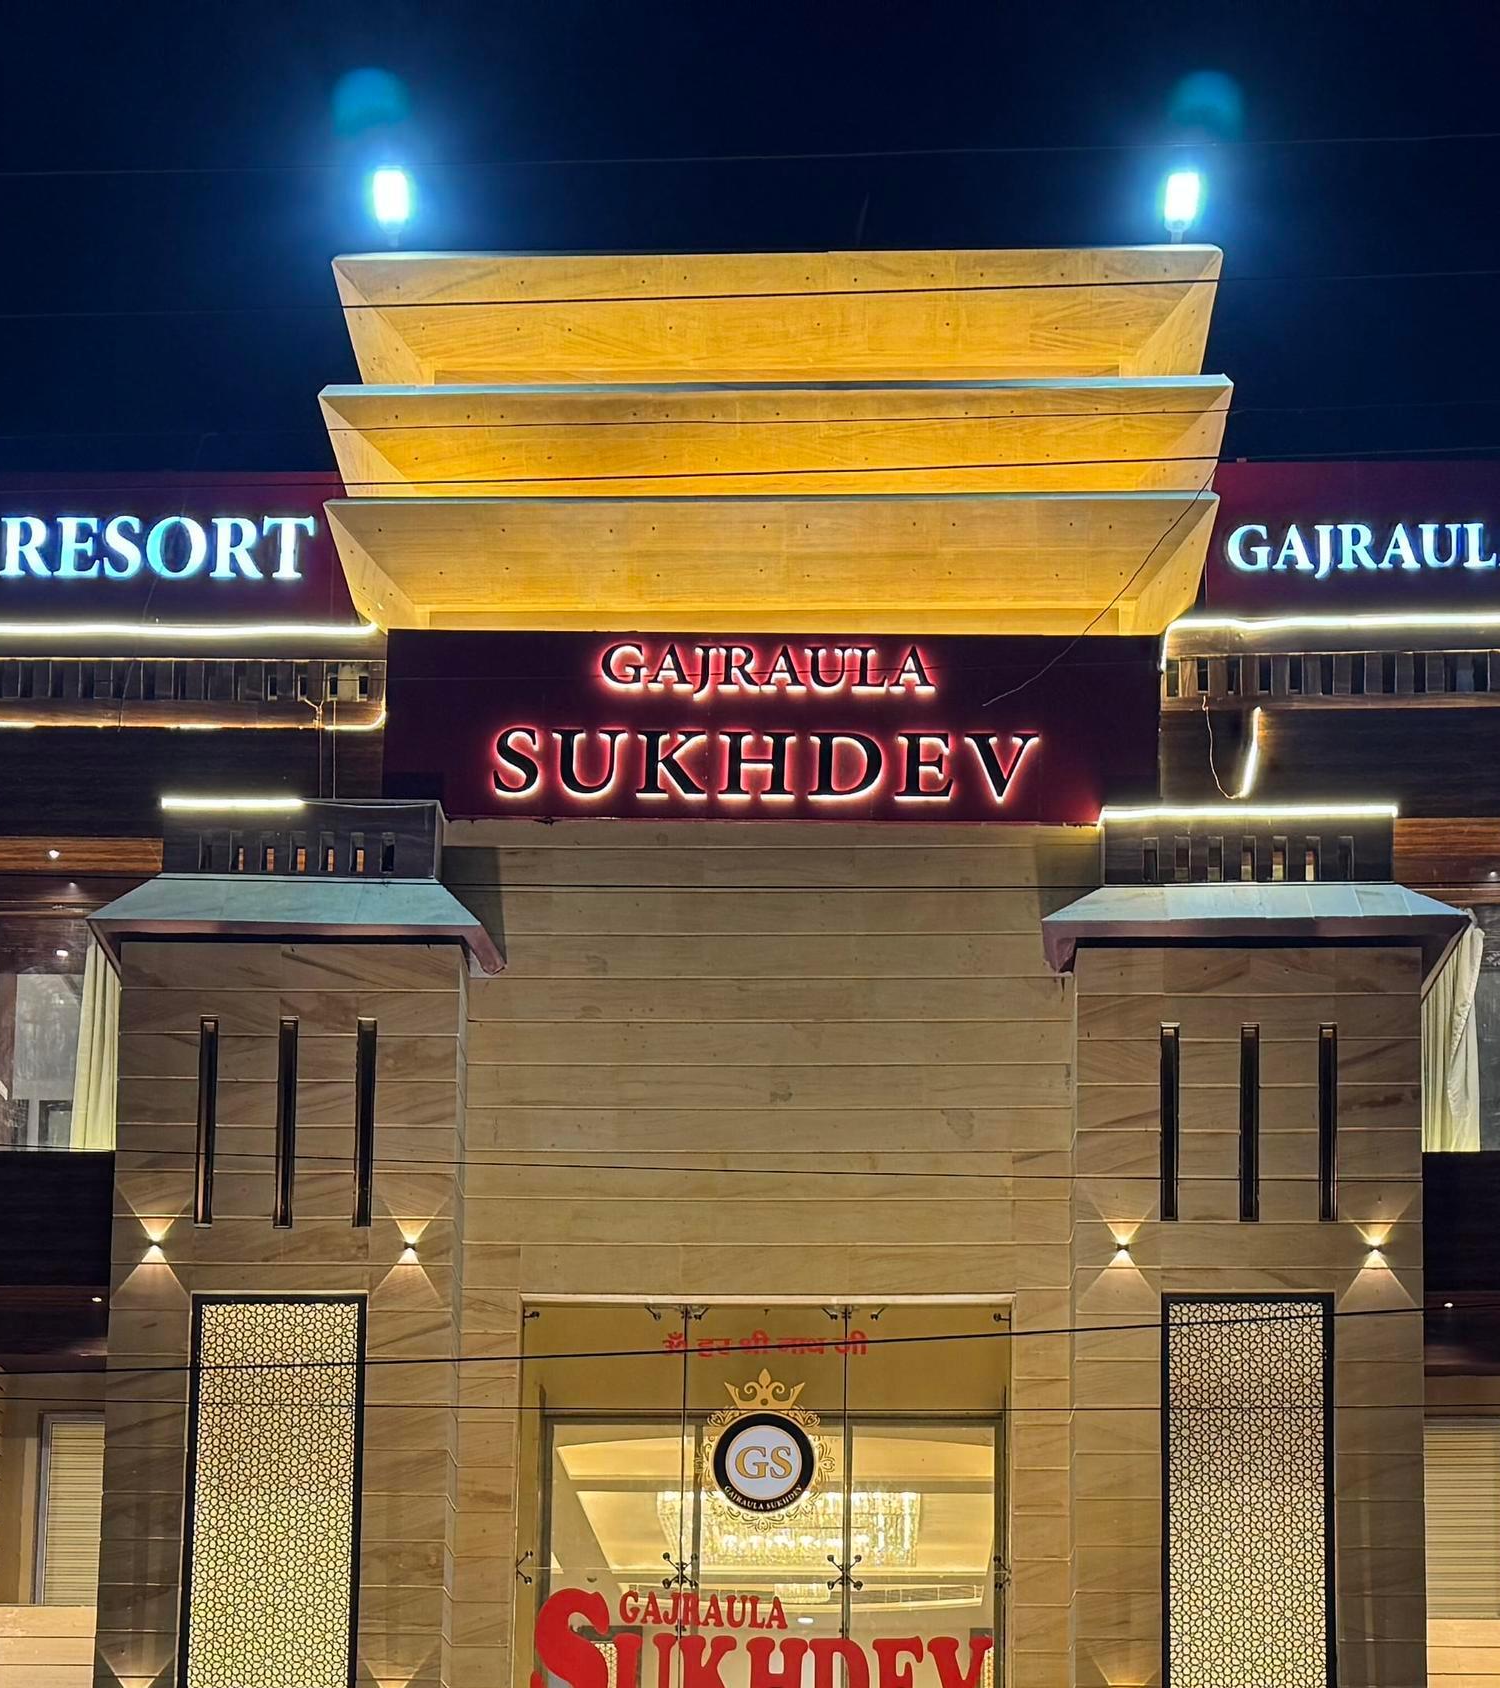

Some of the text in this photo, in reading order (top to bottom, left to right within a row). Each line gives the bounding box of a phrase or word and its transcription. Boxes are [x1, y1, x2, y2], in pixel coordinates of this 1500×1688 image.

[599, 643, 938, 700] GAJRAULA
[491, 725, 1042, 805] SUKHDEV
[739, 1328, 770, 1355] श्री
[735, 1446, 793, 1479] GS
[724, 1484, 802, 1510] GAJRAULA SUKHDEV
[619, 1590, 788, 1630] GAJRAULA
